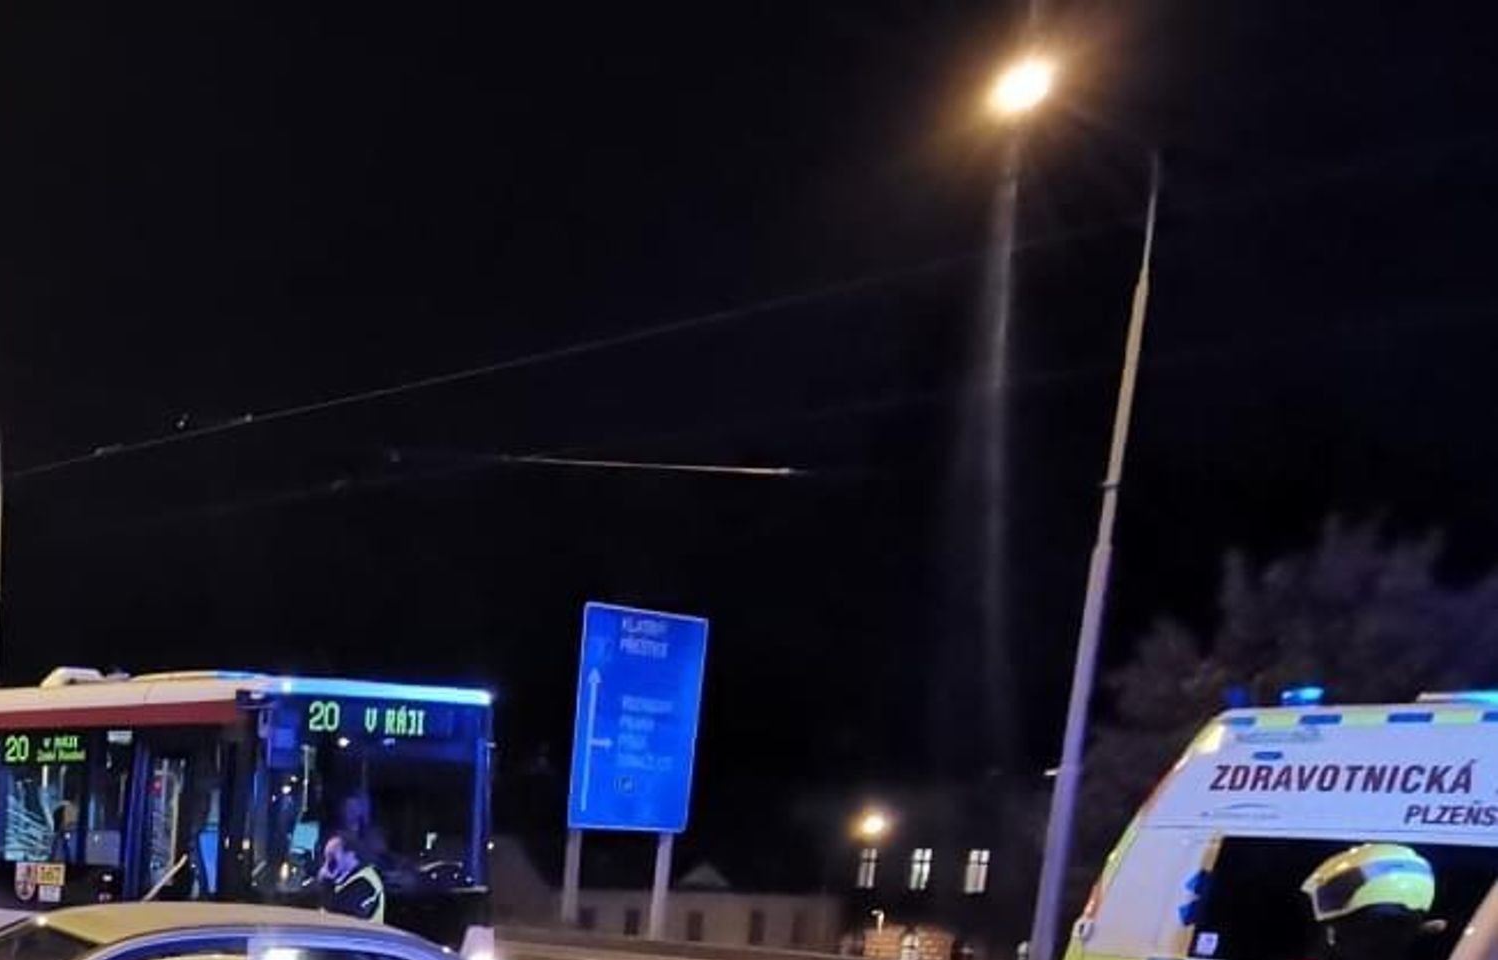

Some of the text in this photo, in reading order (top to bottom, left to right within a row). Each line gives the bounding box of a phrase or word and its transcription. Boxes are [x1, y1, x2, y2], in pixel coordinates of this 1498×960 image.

[308, 700, 340, 731] 20
[364, 707, 378, 733] V
[5, 735, 29, 762] 20
[1208, 758, 1478, 794] ZDRAVOTNICKÁ
